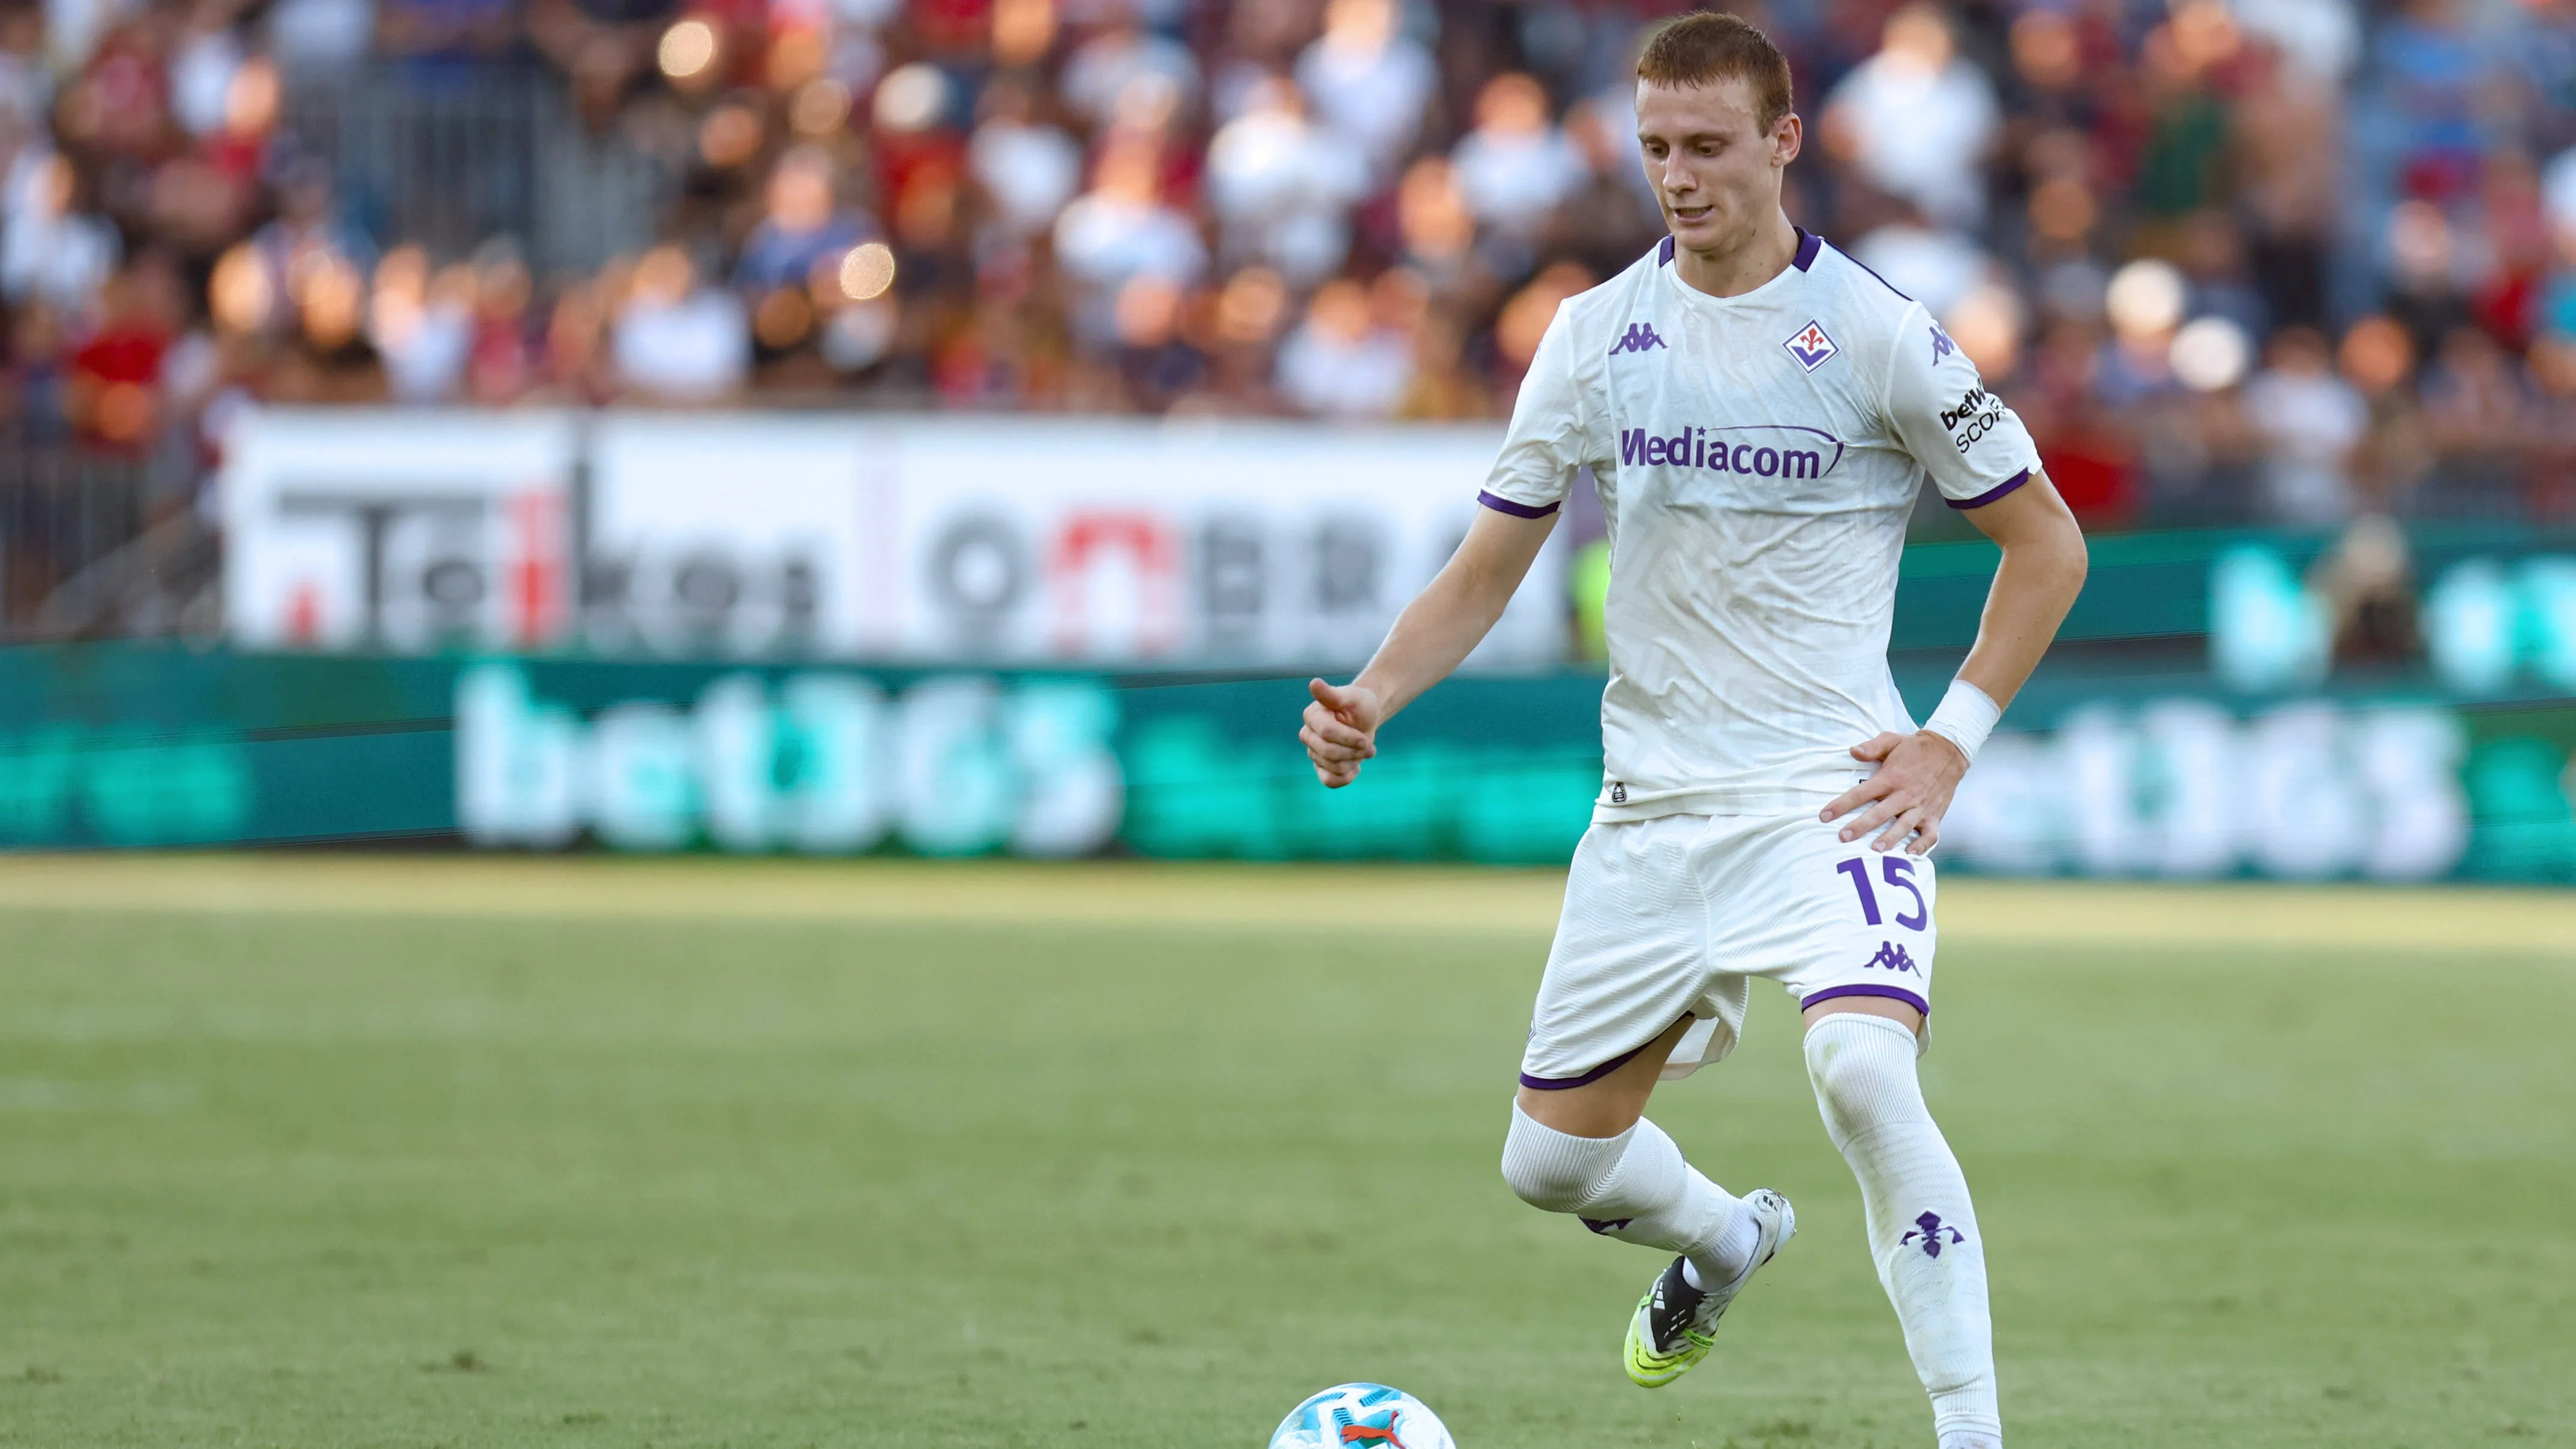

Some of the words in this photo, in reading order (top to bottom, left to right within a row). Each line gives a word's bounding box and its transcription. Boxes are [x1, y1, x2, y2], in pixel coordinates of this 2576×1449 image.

[1621, 425, 1821, 479] Mediacom
[455, 665, 1123, 853] bet365
[1941, 701, 2466, 877] et365
[1837, 855, 1927, 932] 15
